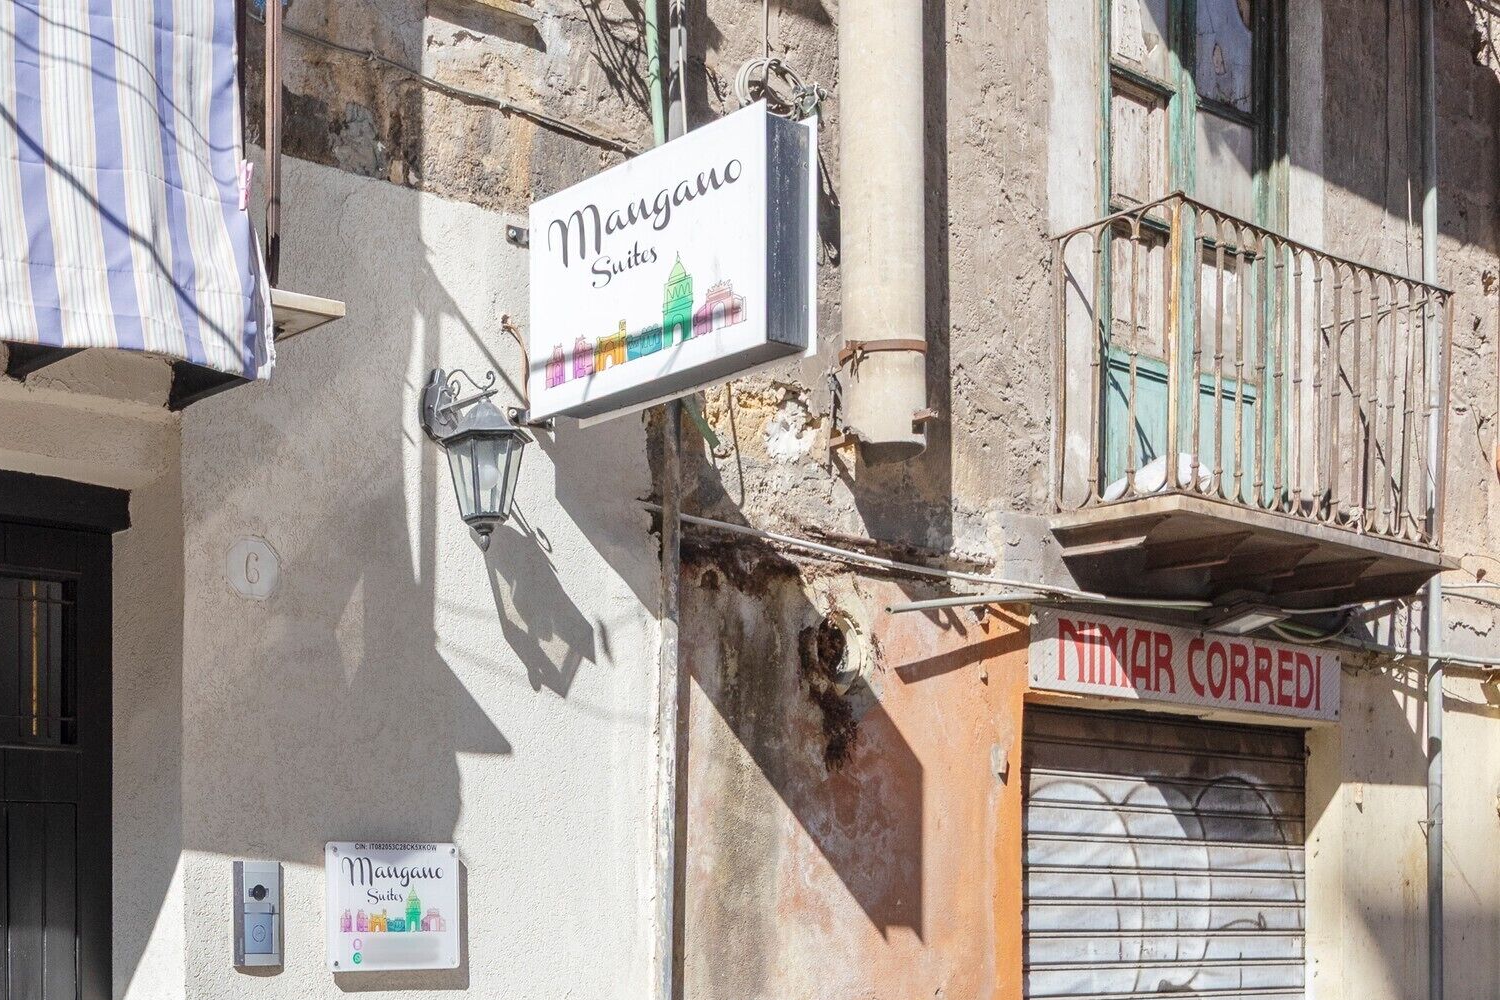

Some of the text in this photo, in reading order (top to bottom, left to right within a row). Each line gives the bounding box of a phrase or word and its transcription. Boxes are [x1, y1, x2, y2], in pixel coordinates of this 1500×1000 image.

[548, 159, 743, 268] Mangano
[591, 240, 658, 289] Suites
[1057, 618, 1322, 711] NIMAR CORREDI
[341, 856, 444, 887] Mangano
[366, 886, 403, 905] Suites
